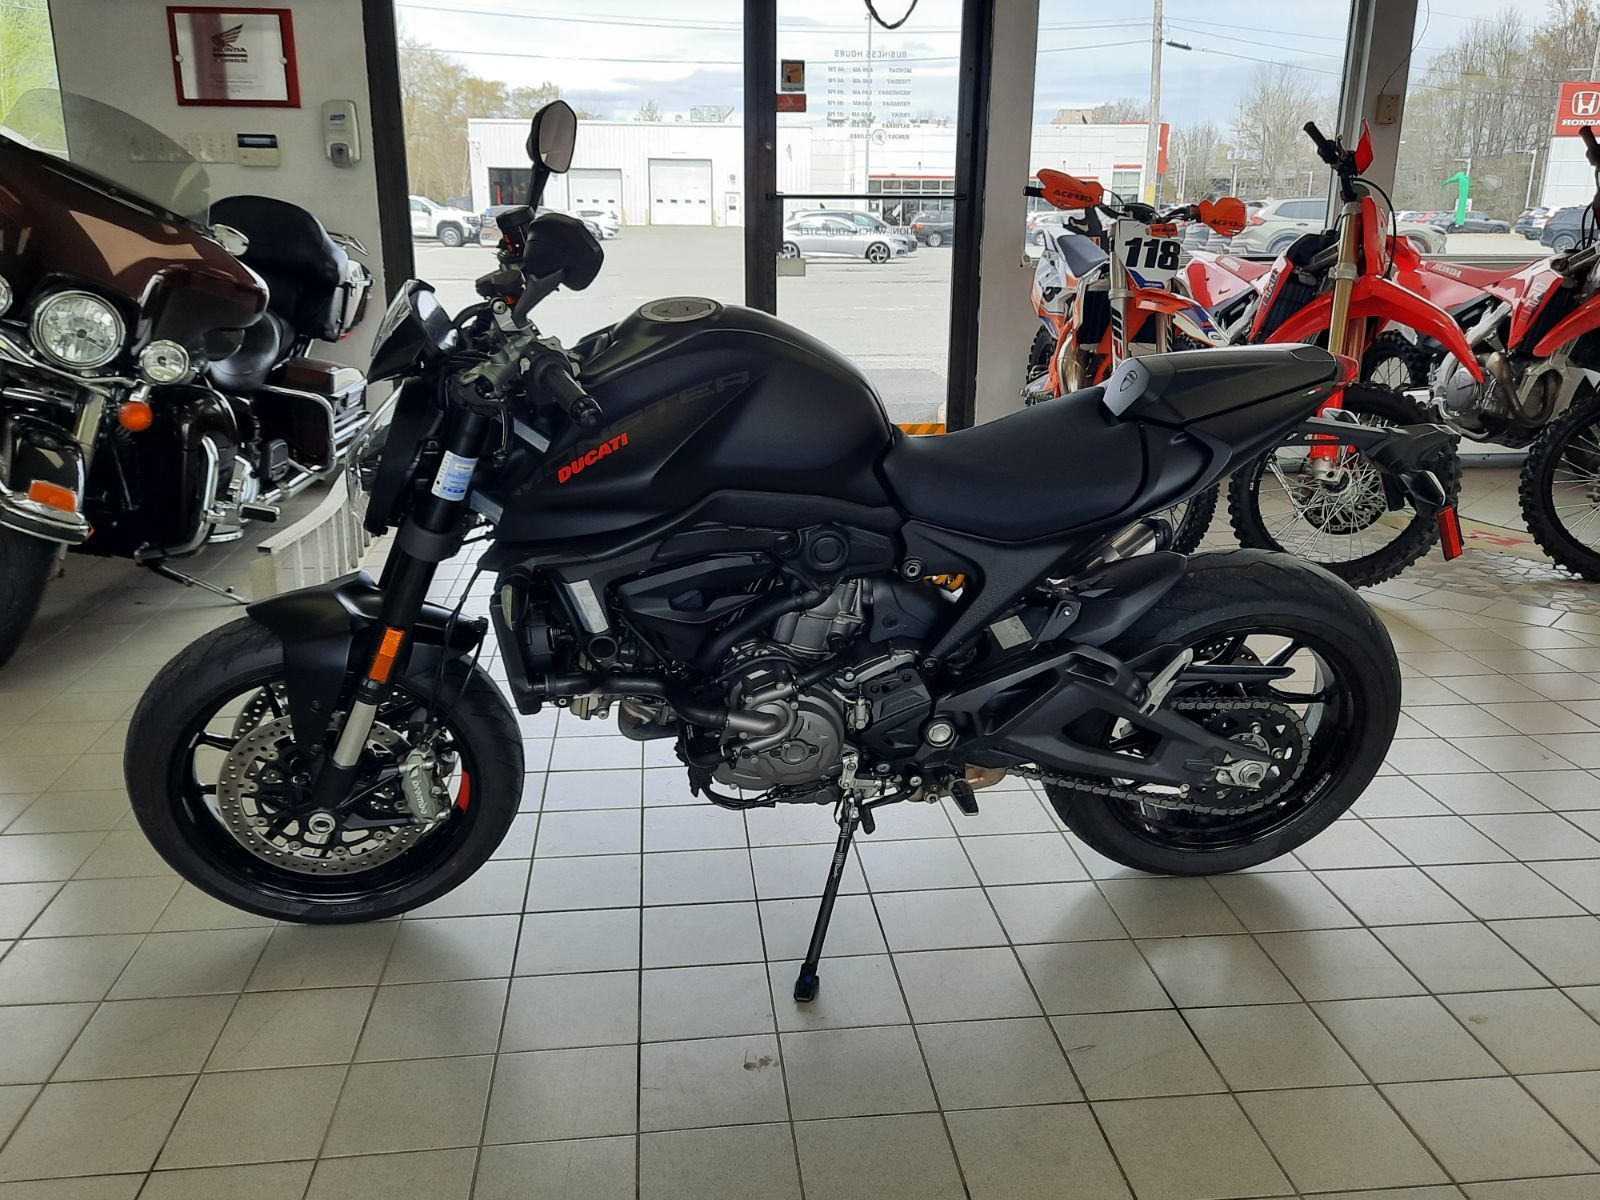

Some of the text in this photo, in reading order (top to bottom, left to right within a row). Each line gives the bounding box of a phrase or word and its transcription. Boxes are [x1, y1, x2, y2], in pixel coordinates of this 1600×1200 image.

[1124, 237, 1181, 271] 118
[1432, 263, 1463, 278] HONDA
[557, 432, 630, 484] DUCATI
[411, 780, 428, 815] brembo
